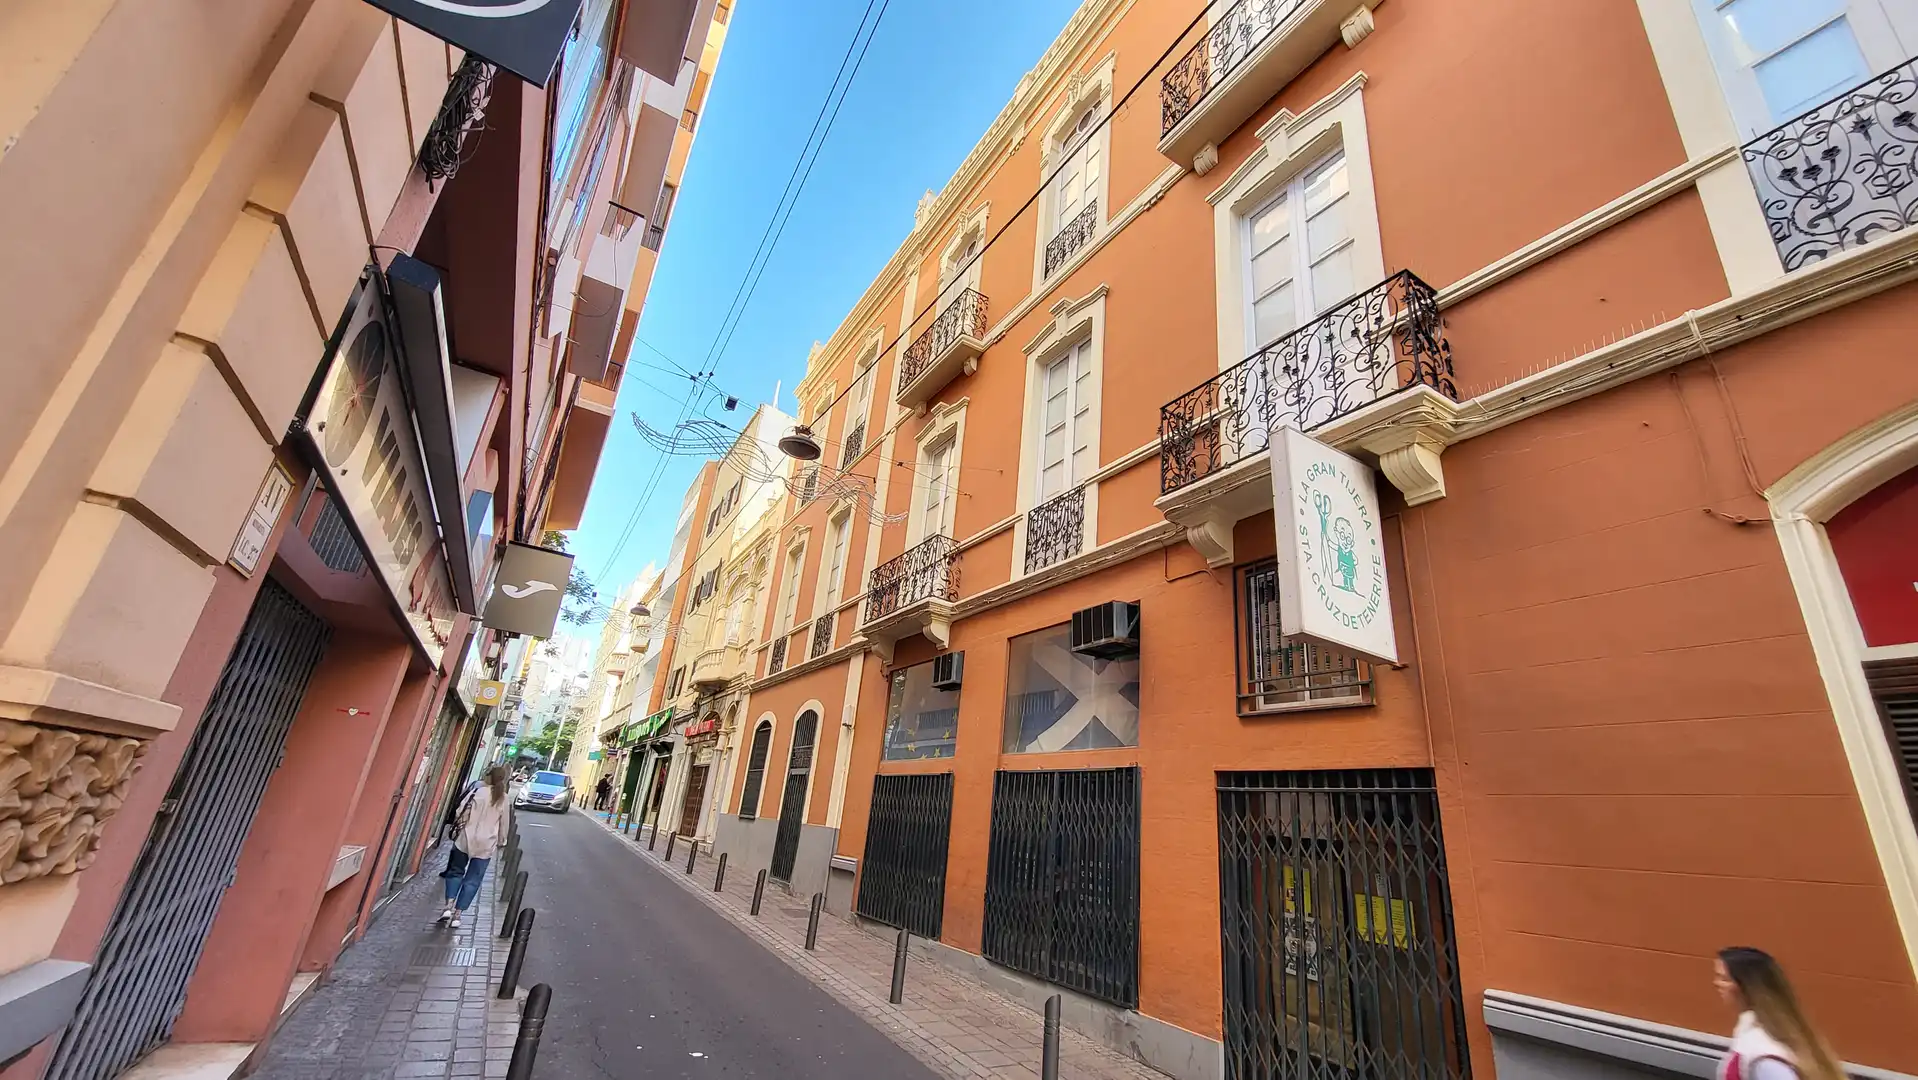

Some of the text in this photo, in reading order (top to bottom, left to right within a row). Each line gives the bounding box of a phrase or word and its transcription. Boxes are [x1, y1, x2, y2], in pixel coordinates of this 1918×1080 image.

[362, 405, 423, 570] VIAJES
[1298, 461, 1372, 531] LA GRAN TIJERA
[1311, 572, 1341, 622] CRUZ
[1342, 612, 1359, 630] DE
[1357, 554, 1382, 628] TENERIFE
